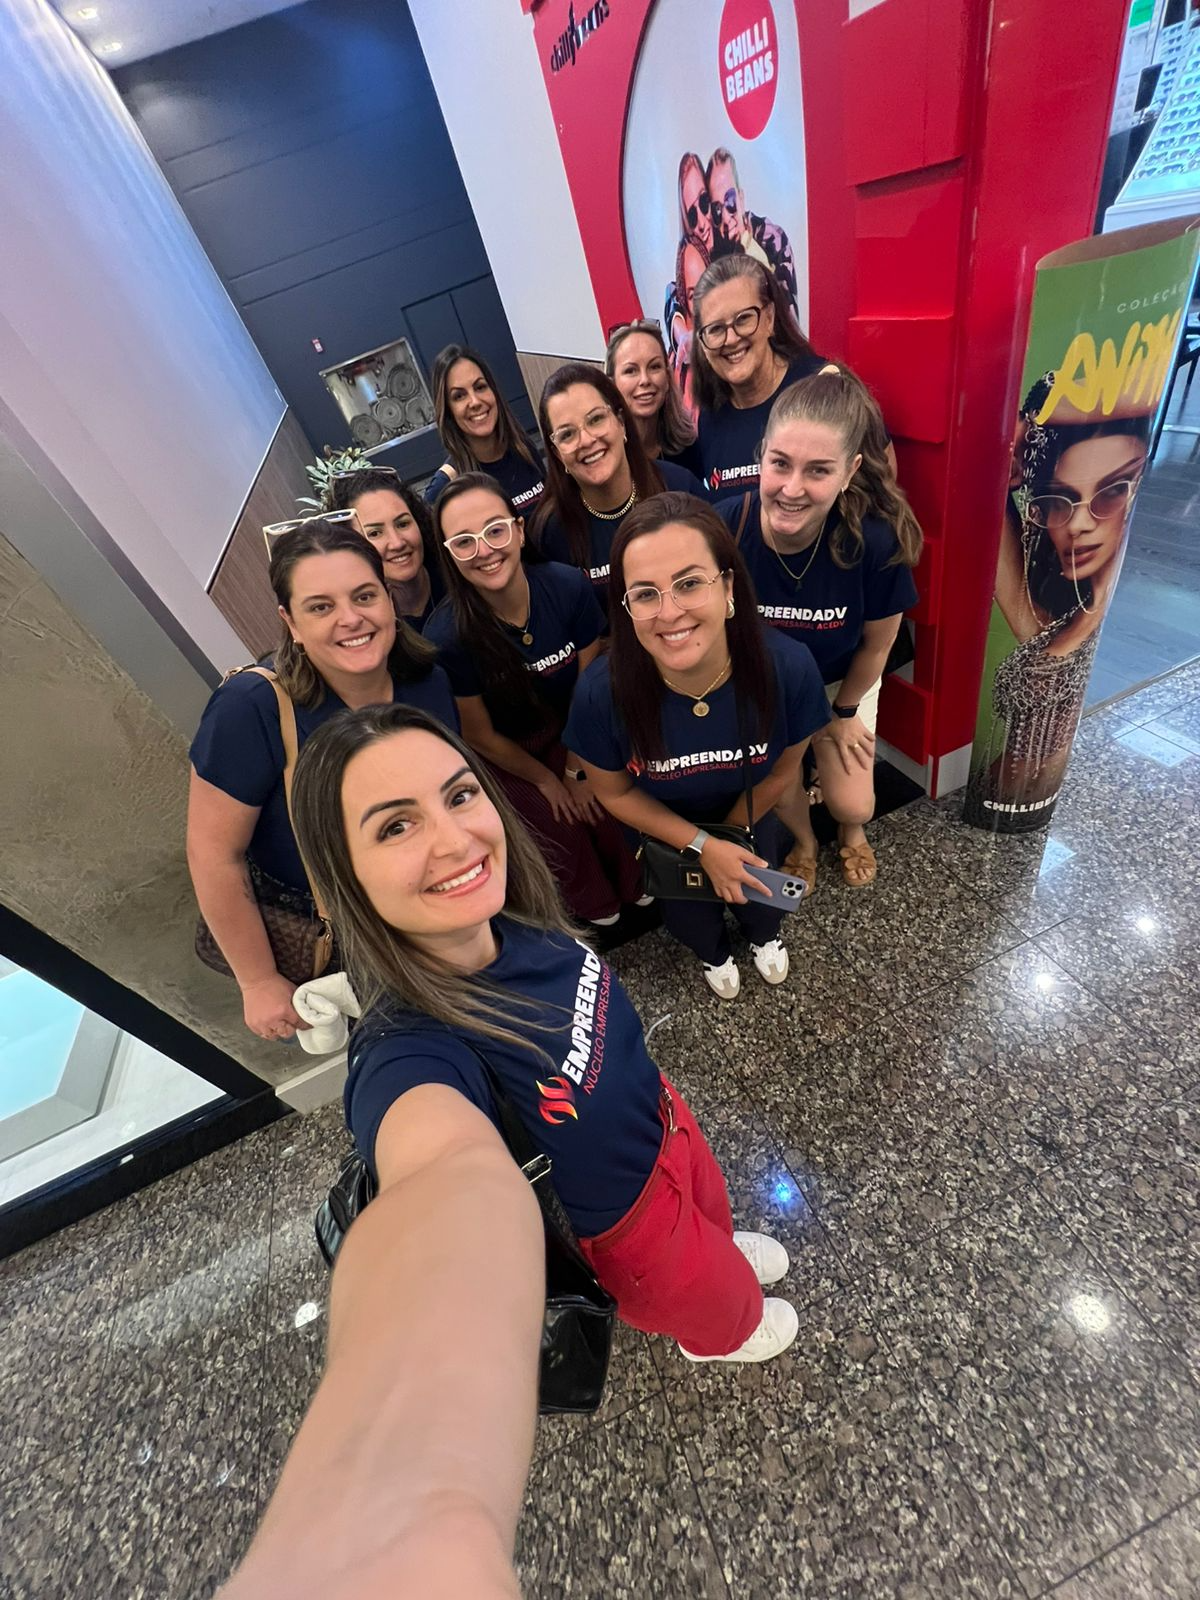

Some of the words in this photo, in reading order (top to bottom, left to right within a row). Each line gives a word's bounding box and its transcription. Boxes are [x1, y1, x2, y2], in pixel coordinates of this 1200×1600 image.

[724, 17, 769, 71] CHILLI
[725, 50, 775, 104] BEANS
[721, 463, 761, 481] EMPREE
[583, 1036, 605, 1095] NÚCLEO
